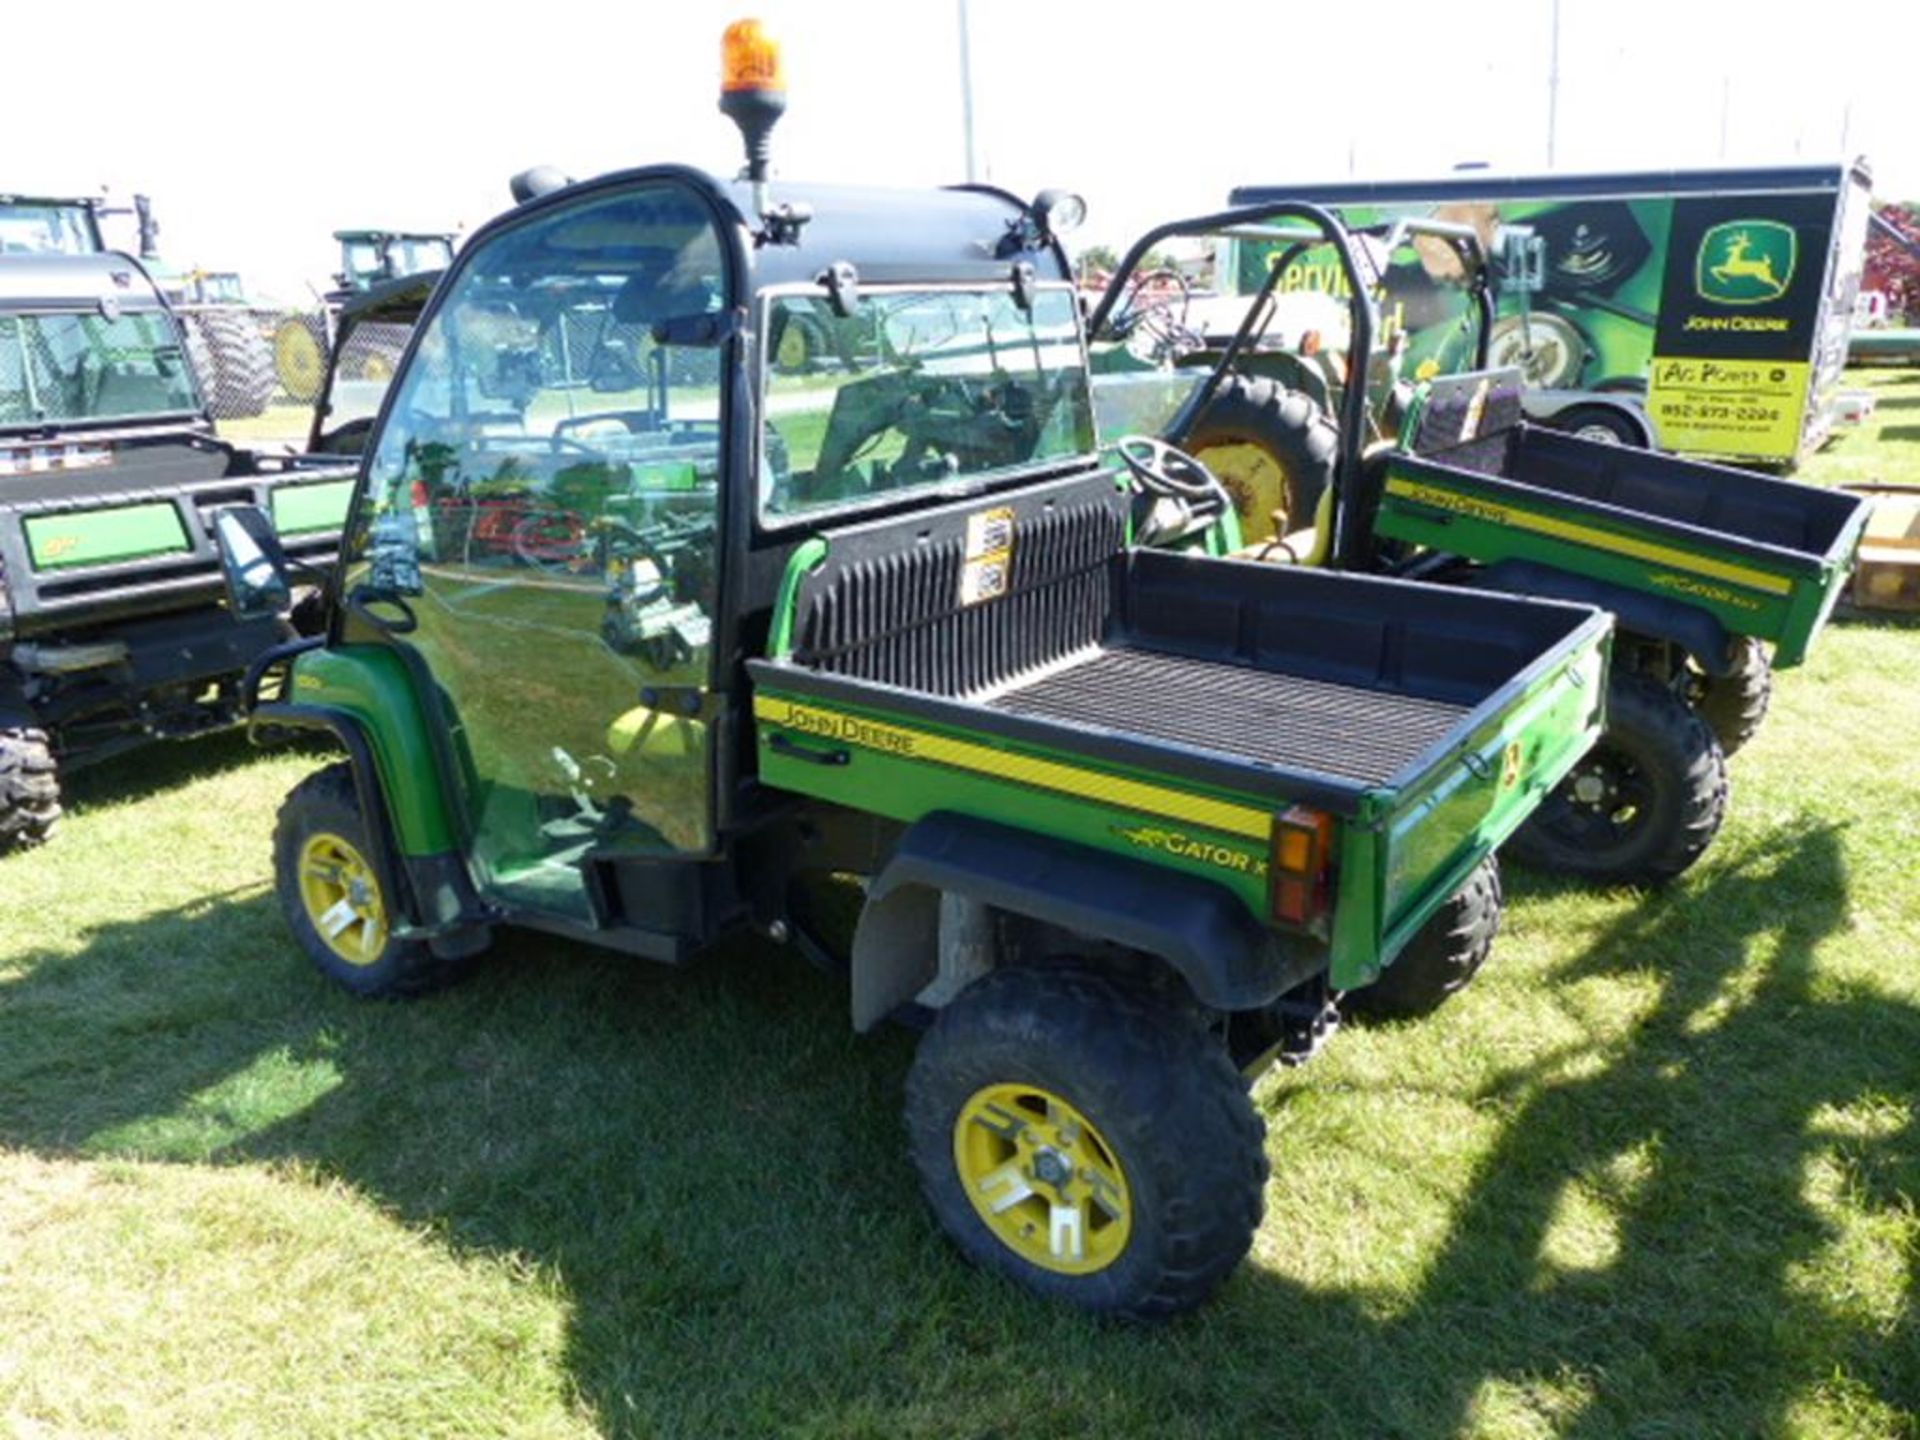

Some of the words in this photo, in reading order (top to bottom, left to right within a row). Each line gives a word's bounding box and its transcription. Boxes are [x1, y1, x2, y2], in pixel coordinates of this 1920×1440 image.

[1682, 315, 1729, 331] JOHN
[783, 704, 839, 734] JOHN
[842, 716, 915, 753] DEERE
[1165, 832, 1249, 871] GATOR
